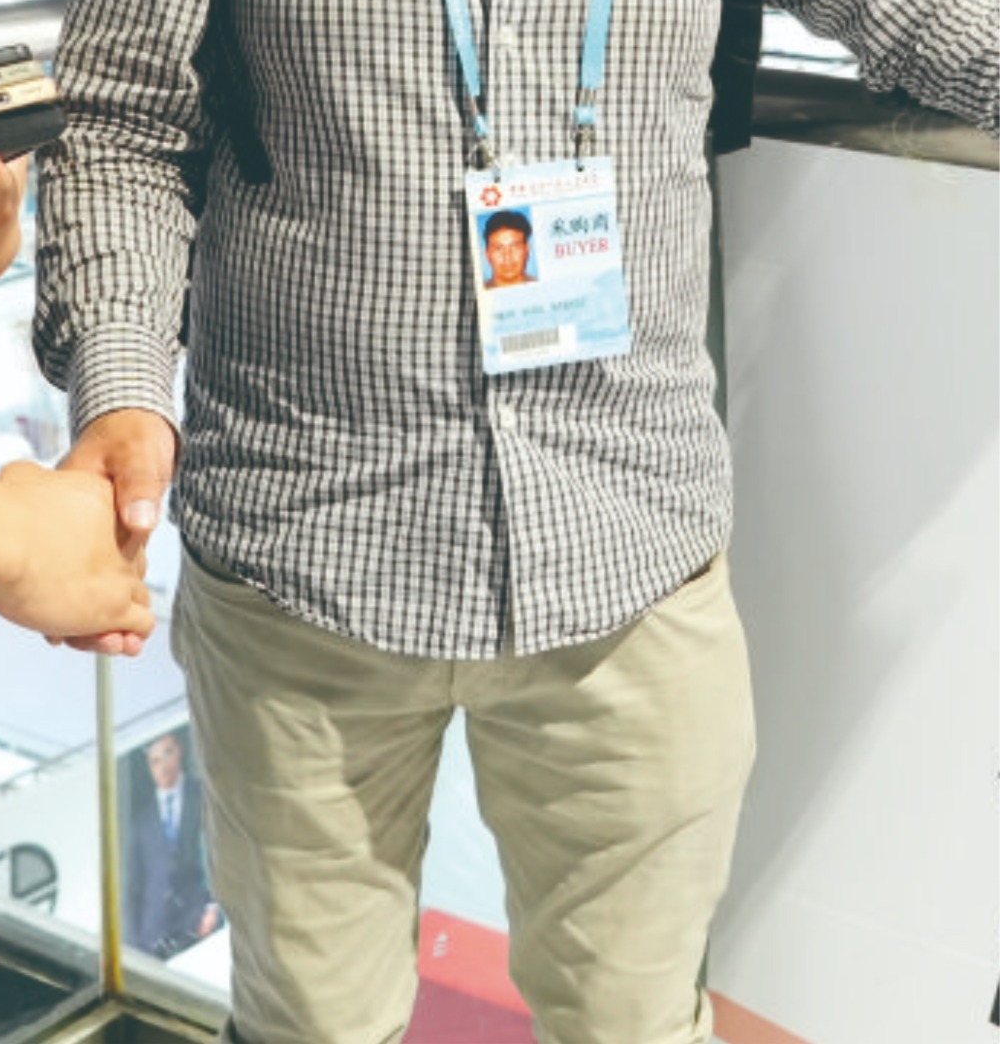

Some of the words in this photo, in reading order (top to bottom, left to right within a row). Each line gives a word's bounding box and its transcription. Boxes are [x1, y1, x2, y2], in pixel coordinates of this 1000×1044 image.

[550, 213, 609, 237] 采购商
[555, 238, 609, 258] BUYER
